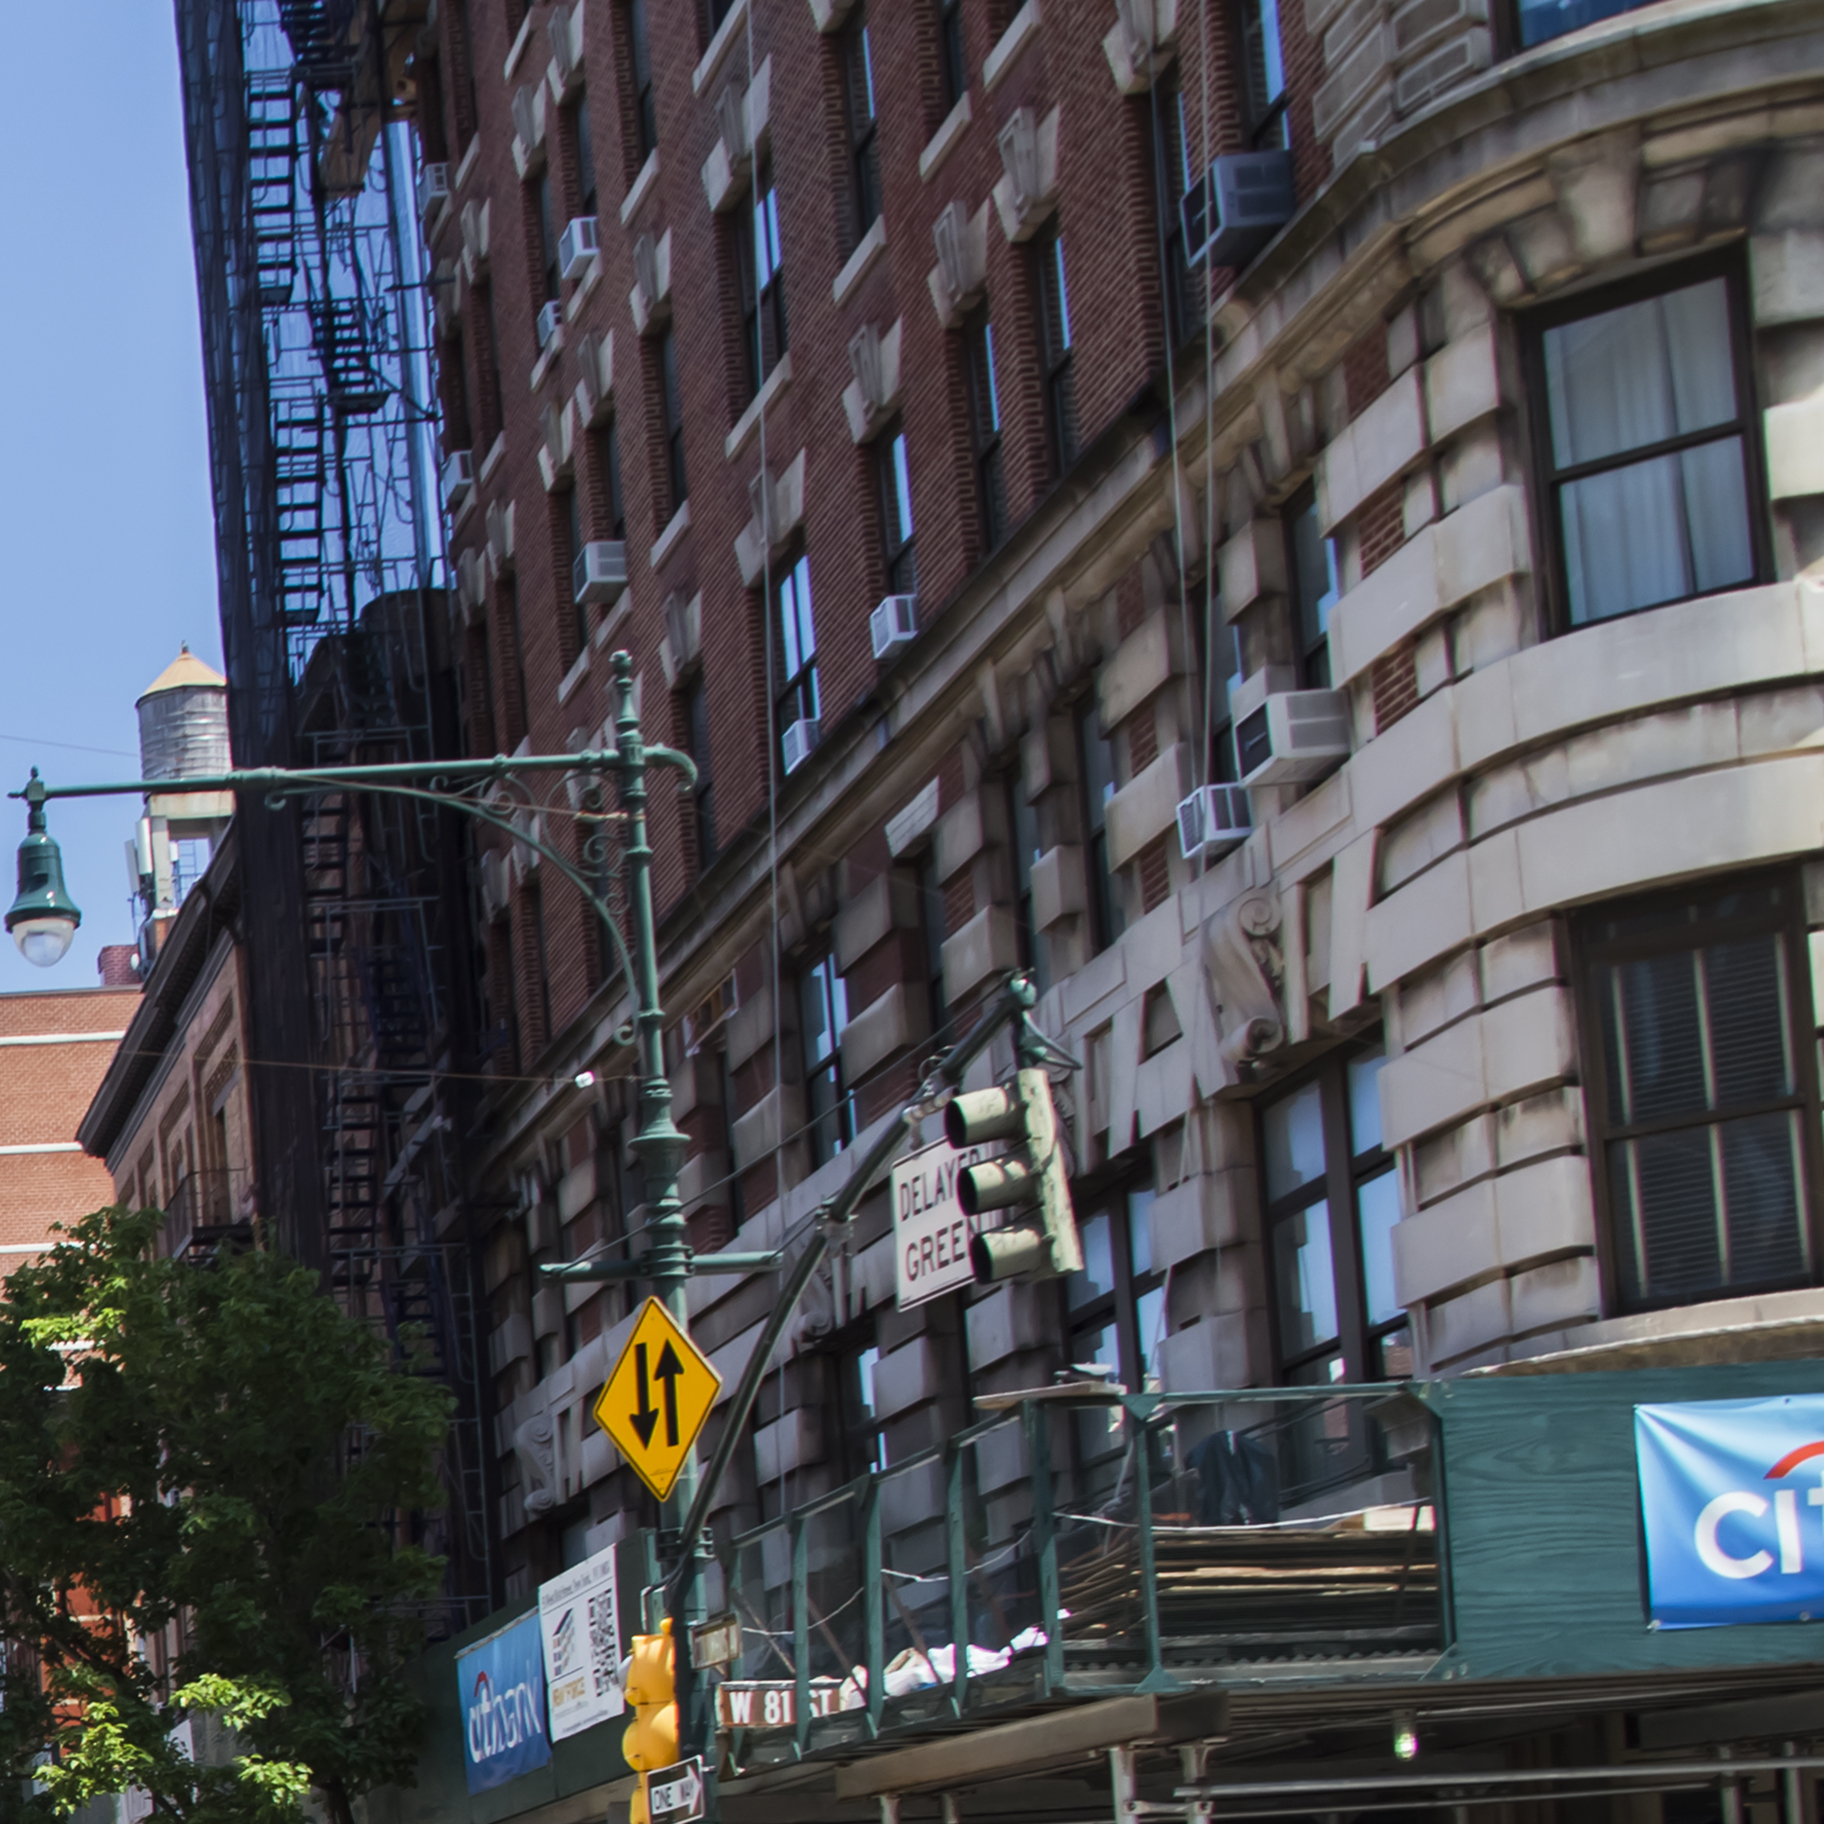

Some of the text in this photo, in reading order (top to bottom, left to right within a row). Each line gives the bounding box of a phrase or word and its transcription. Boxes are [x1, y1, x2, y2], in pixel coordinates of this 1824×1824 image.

[1694, 1470, 1824, 1579] ci
[730, 1692, 752, 1724] W
[764, 1690, 792, 1724] 81
[653, 1786, 673, 1811] ONE
